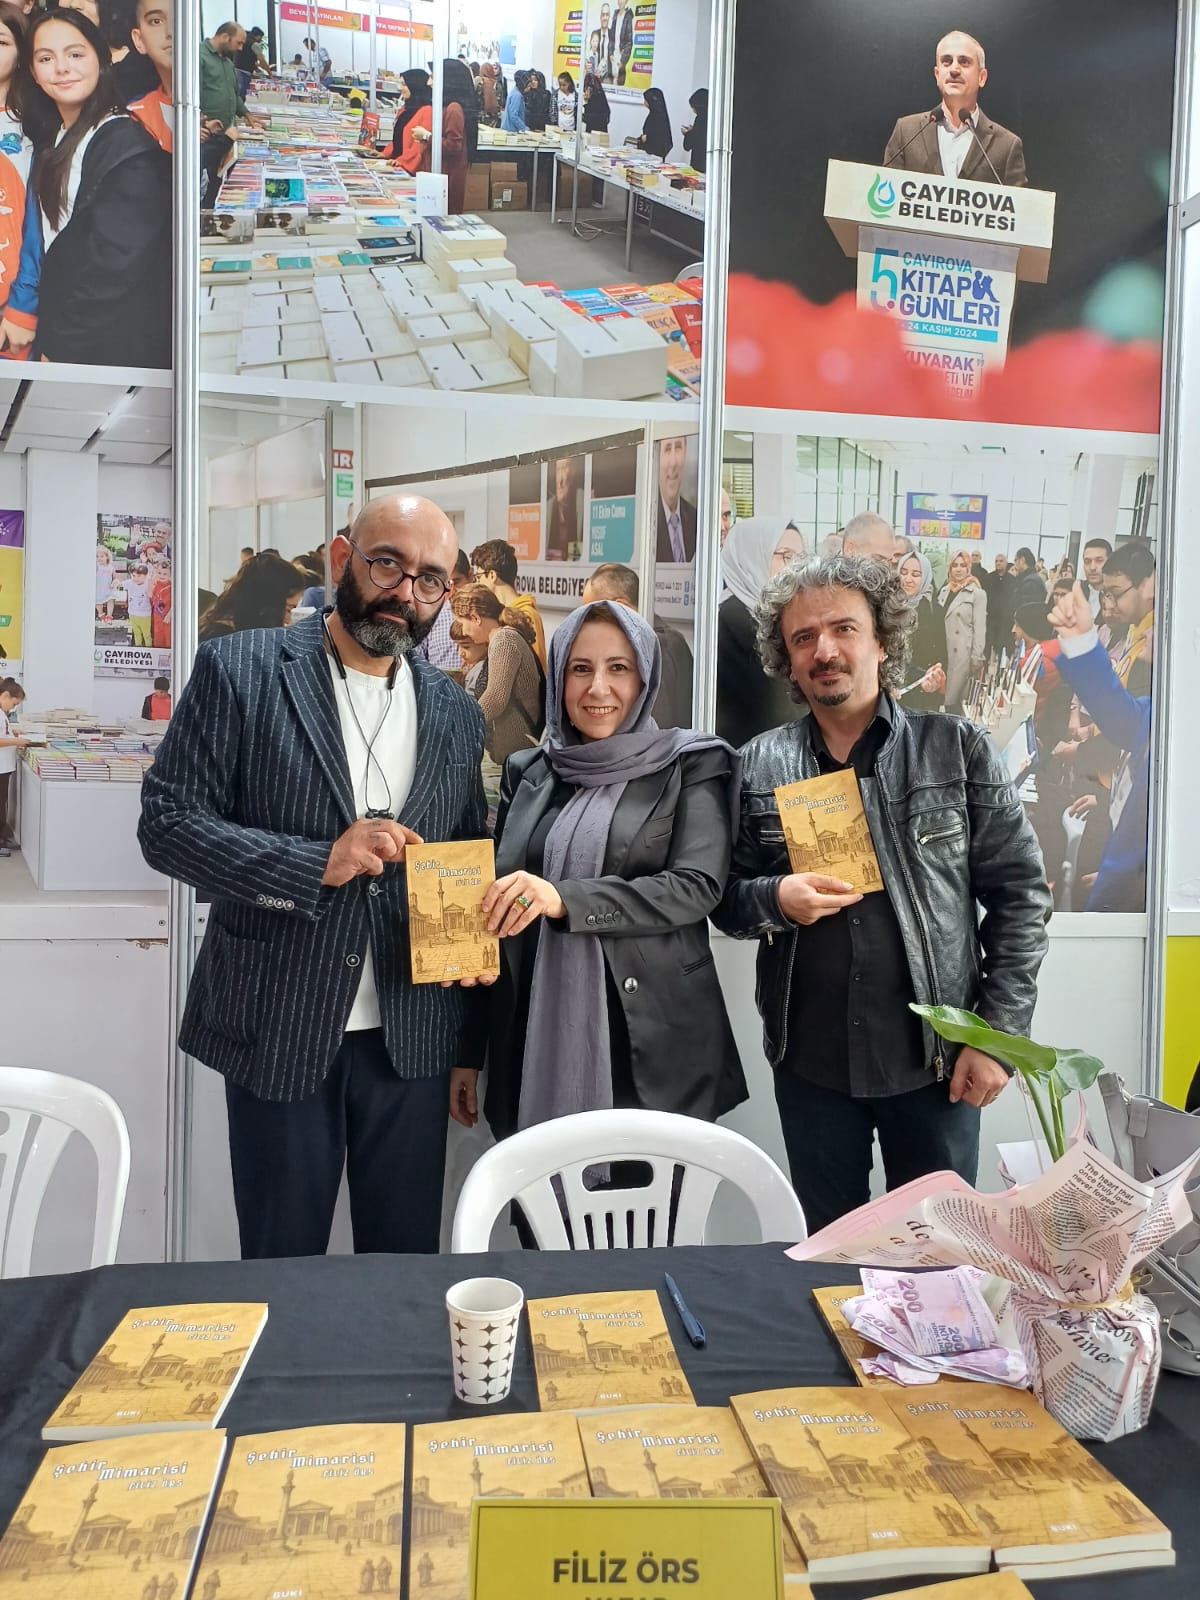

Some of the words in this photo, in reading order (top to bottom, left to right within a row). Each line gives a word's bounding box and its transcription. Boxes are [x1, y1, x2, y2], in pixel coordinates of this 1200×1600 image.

[900, 181, 1016, 213] ÇAYIROVA
[903, 251, 973, 274] ÇAYIROVA
[899, 293, 1000, 327] GÜNLERİ
[922, 324, 952, 335] KASIM
[954, 328, 978, 338] 2024
[962, 373, 975, 386] VE
[516, 576, 536, 593] ROVA
[104, 650, 152, 660] ÇAYIROVA
[1072, 1173, 1093, 1191] never
[1078, 1168, 1097, 1184] once
[1096, 1181, 1115, 1196] truly
[1083, 1162, 1099, 1177] The
[1099, 1174, 1119, 1194] heart
[1118, 1187, 1135, 1200] that
[897, 1278, 924, 1313] 200
[860, 1312, 898, 1335] 200
[754, 1406, 799, 1422] Şehir
[799, 1412, 876, 1426] Mimarisi
[906, 1400, 950, 1416] Şehir
[952, 1408, 1027, 1420] Mimarisi
[429, 1436, 477, 1453] Şehir
[473, 1440, 555, 1457] Mimarisi
[596, 1428, 642, 1444] Şehir
[641, 1433, 720, 1448] Mimarisi
[246, 1448, 297, 1466] Şehir
[290, 1452, 376, 1469] Mimarisi
[53, 1459, 109, 1479] Şehir
[98, 1462, 188, 1481] Mimarisi
[553, 1550, 628, 1583] FİLİZ
[635, 1551, 700, 1584] ÖRS
